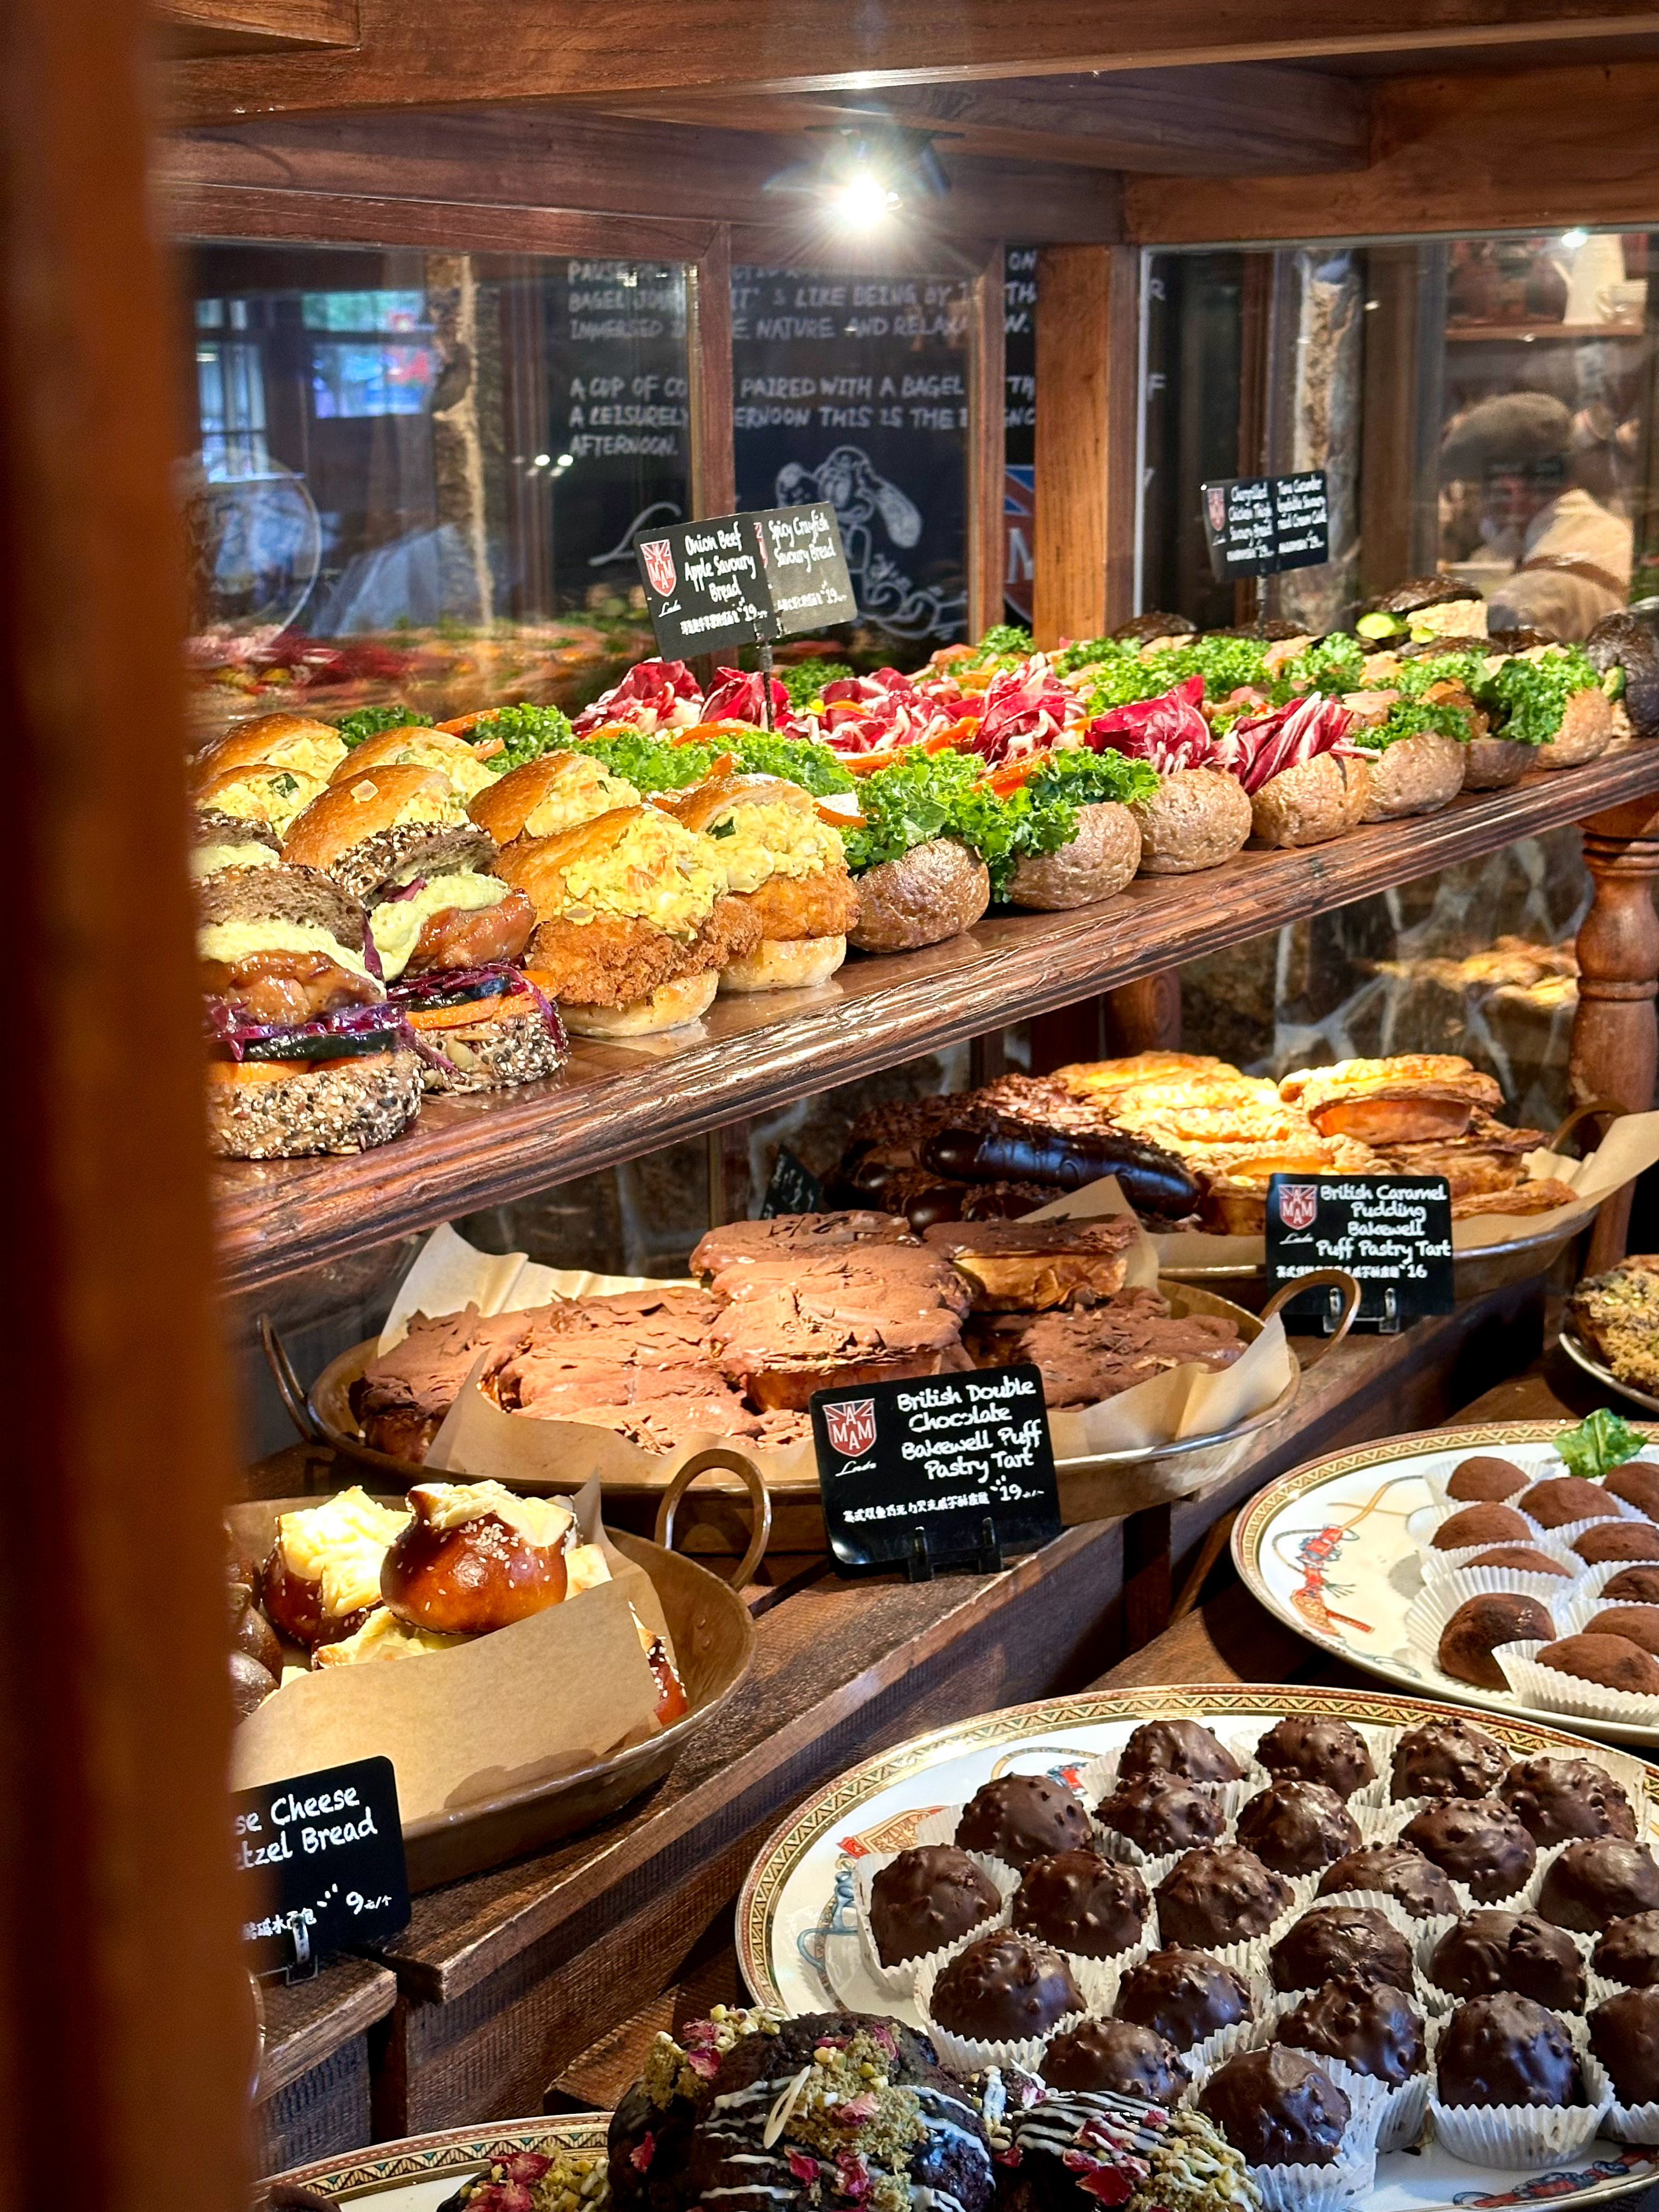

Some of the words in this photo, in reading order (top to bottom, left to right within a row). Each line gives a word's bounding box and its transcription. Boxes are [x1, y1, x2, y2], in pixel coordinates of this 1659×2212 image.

[795, 287, 846, 308] LIKE
[755, 315, 836, 340] NATURE
[741, 375, 816, 399] PAIRED
[820, 375, 873, 399] WITH
[879, 376, 896, 398] A
[901, 375, 965, 399] BAGEL
[569, 405, 584, 428] A
[817, 405, 874, 428] THIS
[910, 407, 955, 430] THE
[685, 531, 716, 556] Onion
[718, 521, 742, 551] Beef
[809, 537, 837, 561] Bread
[684, 557, 714, 592] Apple
[714, 554, 757, 580] Savoury
[708, 574, 742, 603] Bread
[1320, 1183, 1374, 1201] British
[1376, 1184, 1448, 1201] Caramel
[1350, 1201, 1427, 1223] Pudding
[1347, 1219, 1426, 1237] Bakewell
[1316, 1237, 1356, 1261] Puff
[1358, 1239, 1414, 1264] Pastry
[1415, 1239, 1452, 1257] Tart
[1407, 1264, 1428, 1278] 16
[897, 1386, 962, 1413] British
[966, 1375, 1036, 1402] Double
[909, 1403, 1013, 1432] Chocolate
[901, 1431, 994, 1461] Bakewell
[997, 1419, 1043, 1448] Puff
[924, 1456, 990, 1483] Pastry
[991, 1447, 1035, 1469] Tart
[270, 1787, 360, 1826] Cheese
[301, 1806, 379, 1854] Bread
